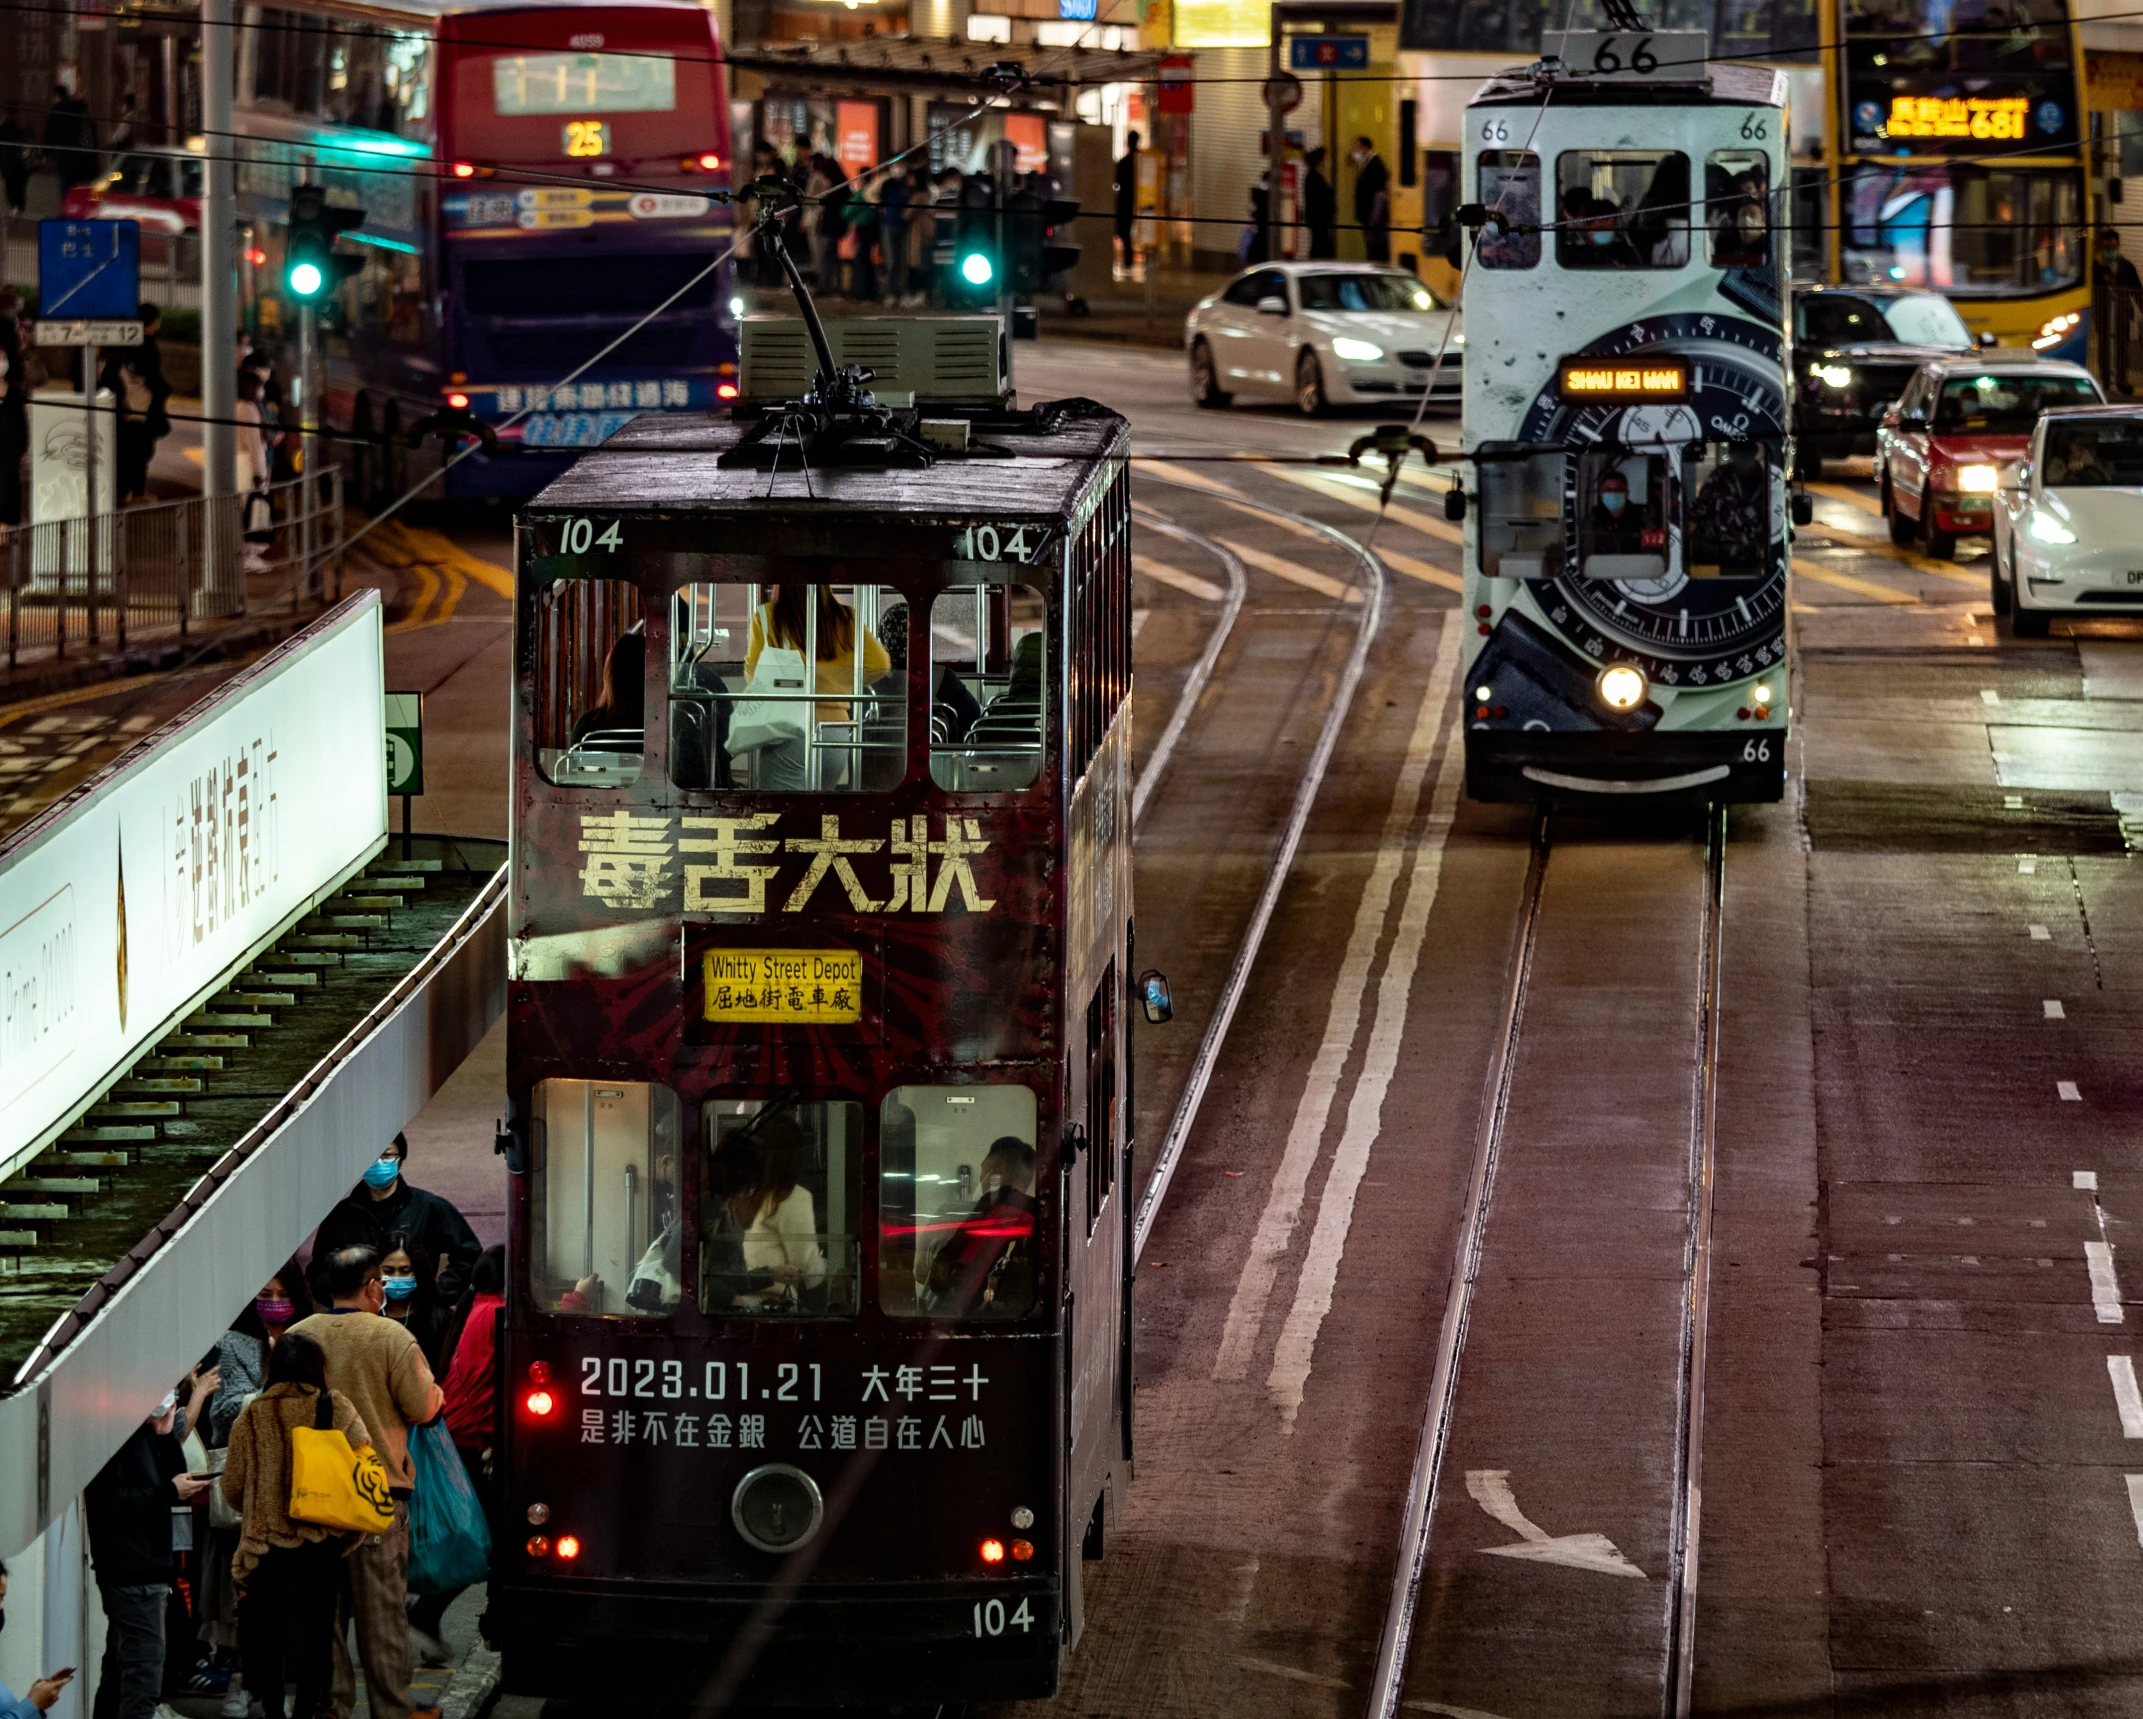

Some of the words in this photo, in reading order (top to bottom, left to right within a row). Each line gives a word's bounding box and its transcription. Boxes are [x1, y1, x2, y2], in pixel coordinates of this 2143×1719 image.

[1594, 37, 1658, 74] 66
[1482, 120, 1508, 141] 66
[1741, 112, 1767, 140] 66
[1970, 110, 2024, 138] 681
[566, 120, 603, 157] 25
[60, 326, 73, 340] 7
[120, 326, 139, 341] 12
[1568, 370, 1613, 390] SHAU
[1615, 370, 1641, 390] KEI
[1643, 370, 1679, 390] WAN
[560, 518, 624, 554] 104
[965, 525, 1032, 562] 104
[1743, 738, 1770, 762] 66
[578, 810, 997, 914] 毒舌大狀
[712, 956, 757, 984] Whitty
[763, 956, 807, 980] Street
[813, 956, 856, 984] Depot
[712, 985, 855, 1012] 屈地街電車廠
[581, 1357, 821, 1401] 2023.01.21
[861, 1363, 990, 1402] 大年三十
[580, 1408, 766, 1448] 是非不在金銀
[797, 1413, 986, 1450] 公道自在人心
[974, 1595, 1035, 1639] 104
